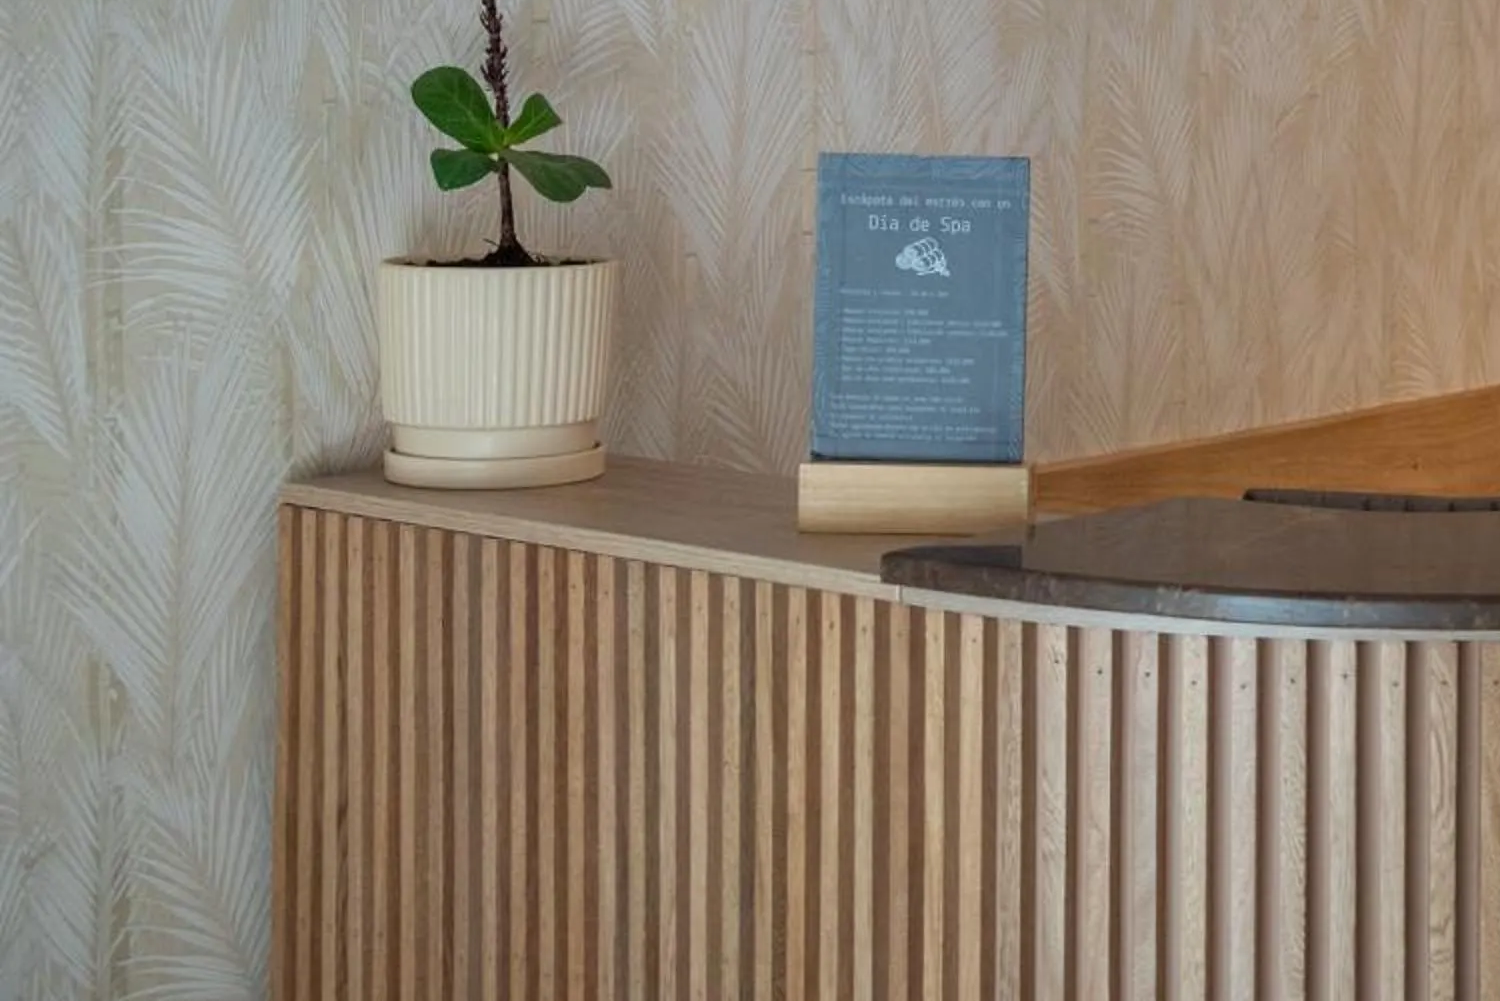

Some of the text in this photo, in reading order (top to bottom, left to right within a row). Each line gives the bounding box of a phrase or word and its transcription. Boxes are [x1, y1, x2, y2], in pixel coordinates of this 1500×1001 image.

[899, 195, 919, 206] del
[971, 198, 992, 209] con
[869, 214, 971, 234] Día de Spa
